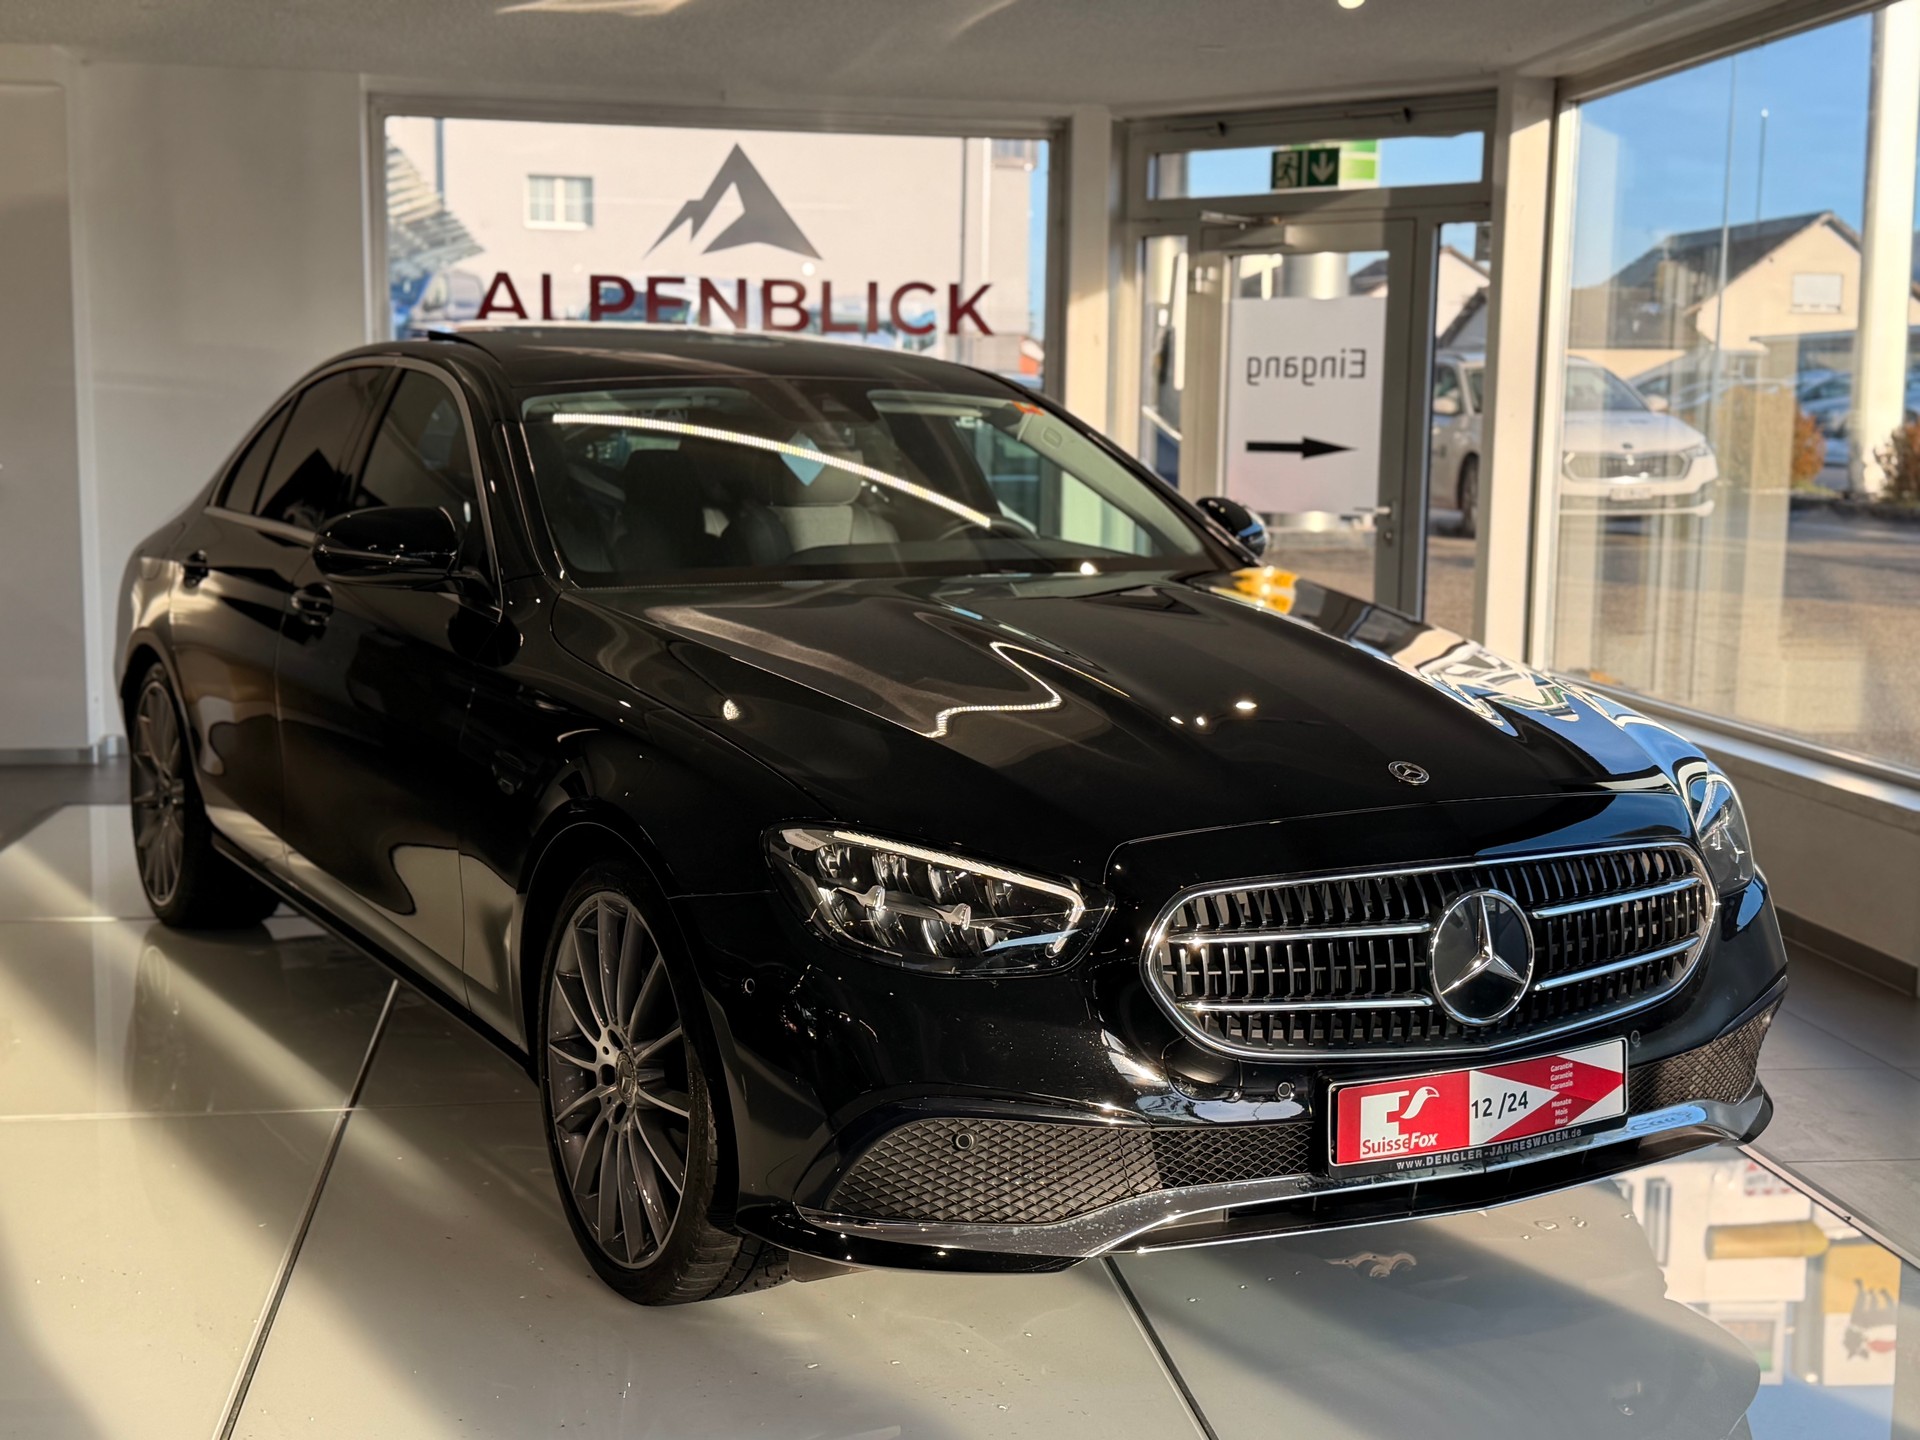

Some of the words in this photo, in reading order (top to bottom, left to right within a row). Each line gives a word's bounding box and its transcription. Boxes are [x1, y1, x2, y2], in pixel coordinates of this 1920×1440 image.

[474, 271, 994, 336] ALPENBLICK
[1471, 1098, 1493, 1119] 12
[1362, 1131, 1439, 1155] SuisseFox
[1396, 1128, 1582, 1169] www.DENGLER-JAHRESWAGEN.de
